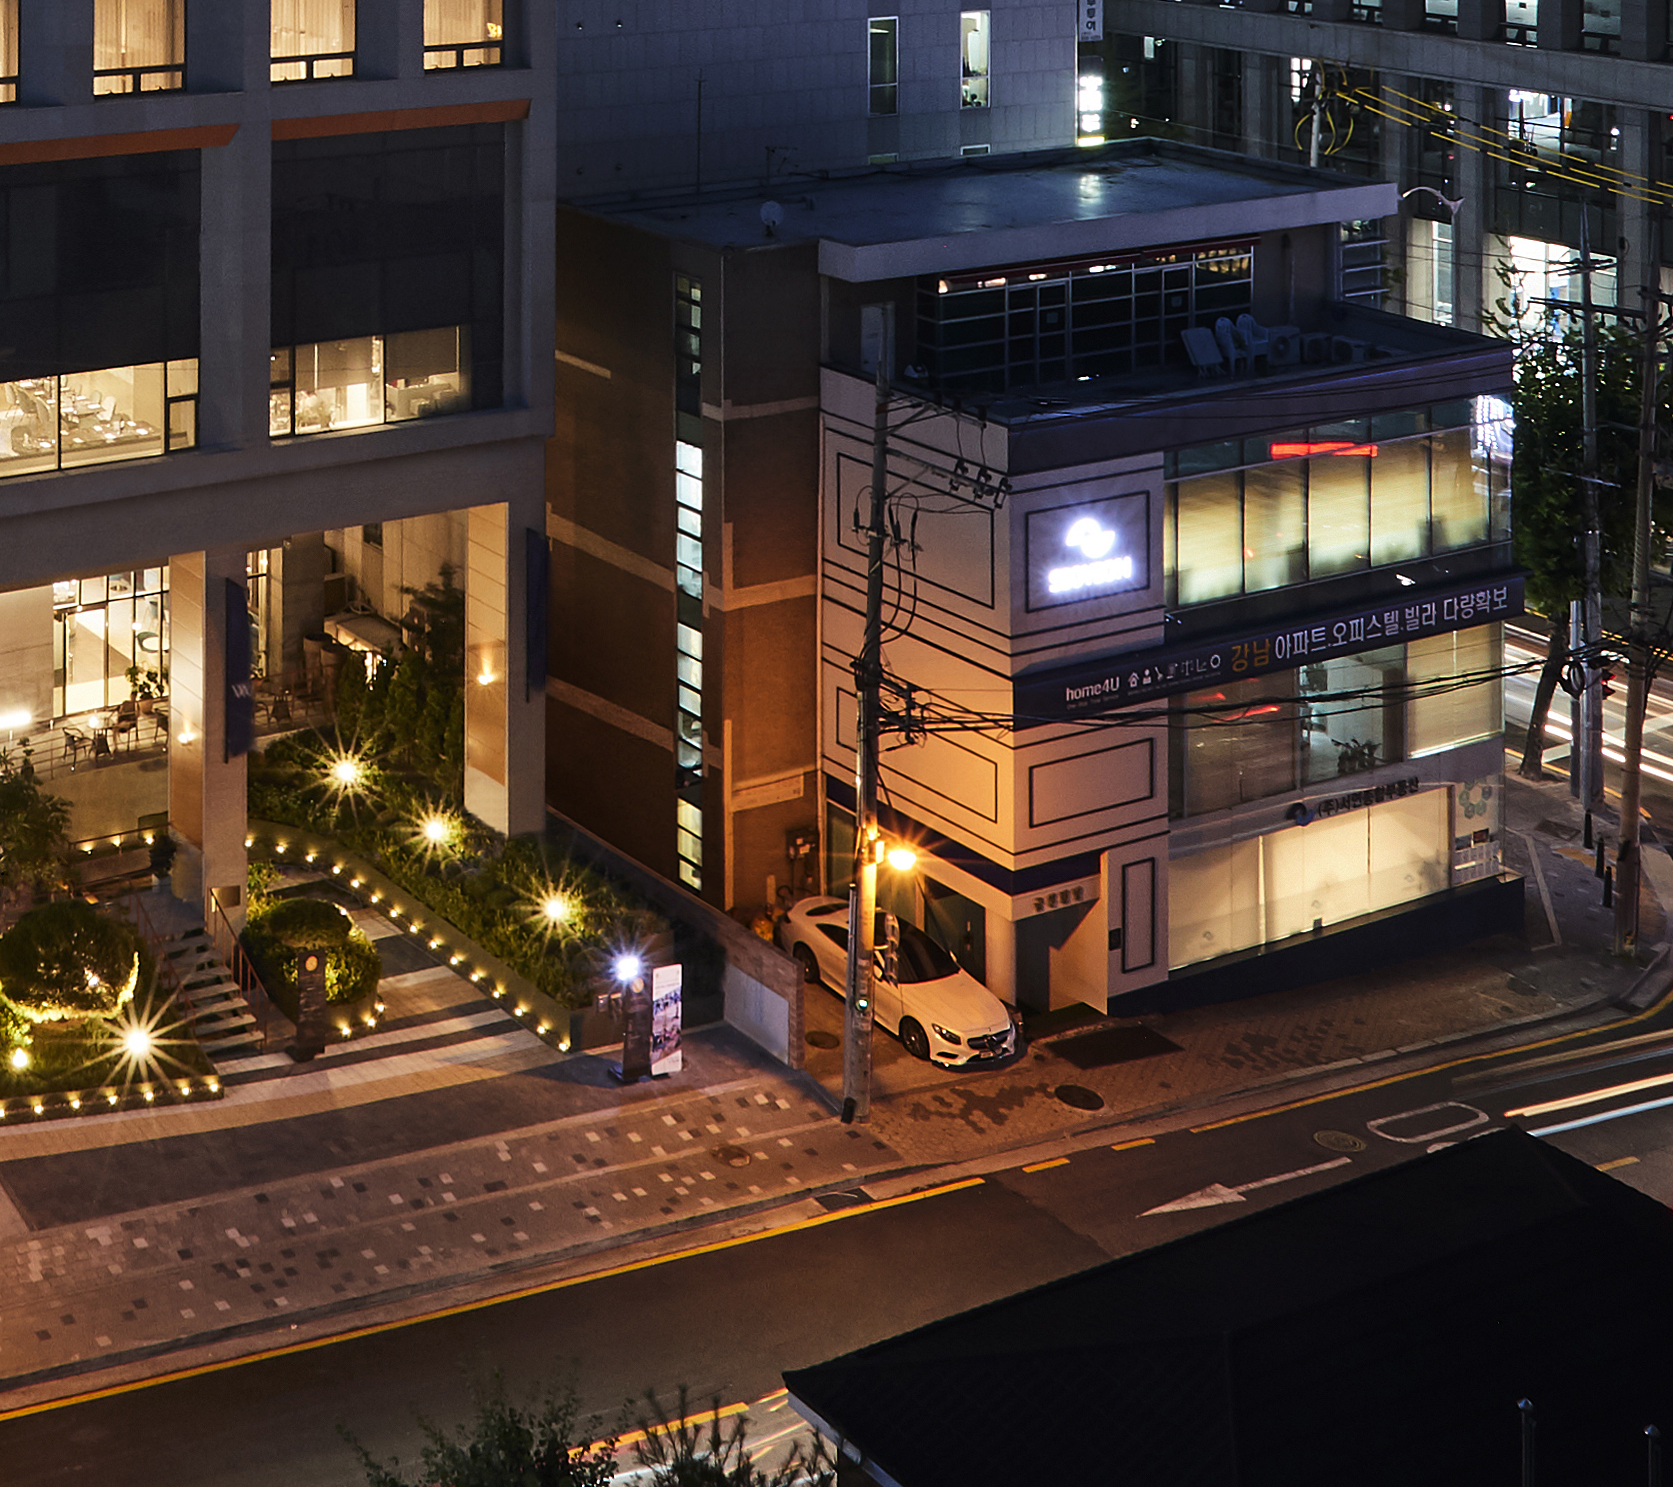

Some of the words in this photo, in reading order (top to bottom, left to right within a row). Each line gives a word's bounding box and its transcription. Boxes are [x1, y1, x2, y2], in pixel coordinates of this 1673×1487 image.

[1231, 638, 1270, 672] 강남
[1443, 586, 1508, 621] 다량확보
[1065, 676, 1120, 702] home4U
